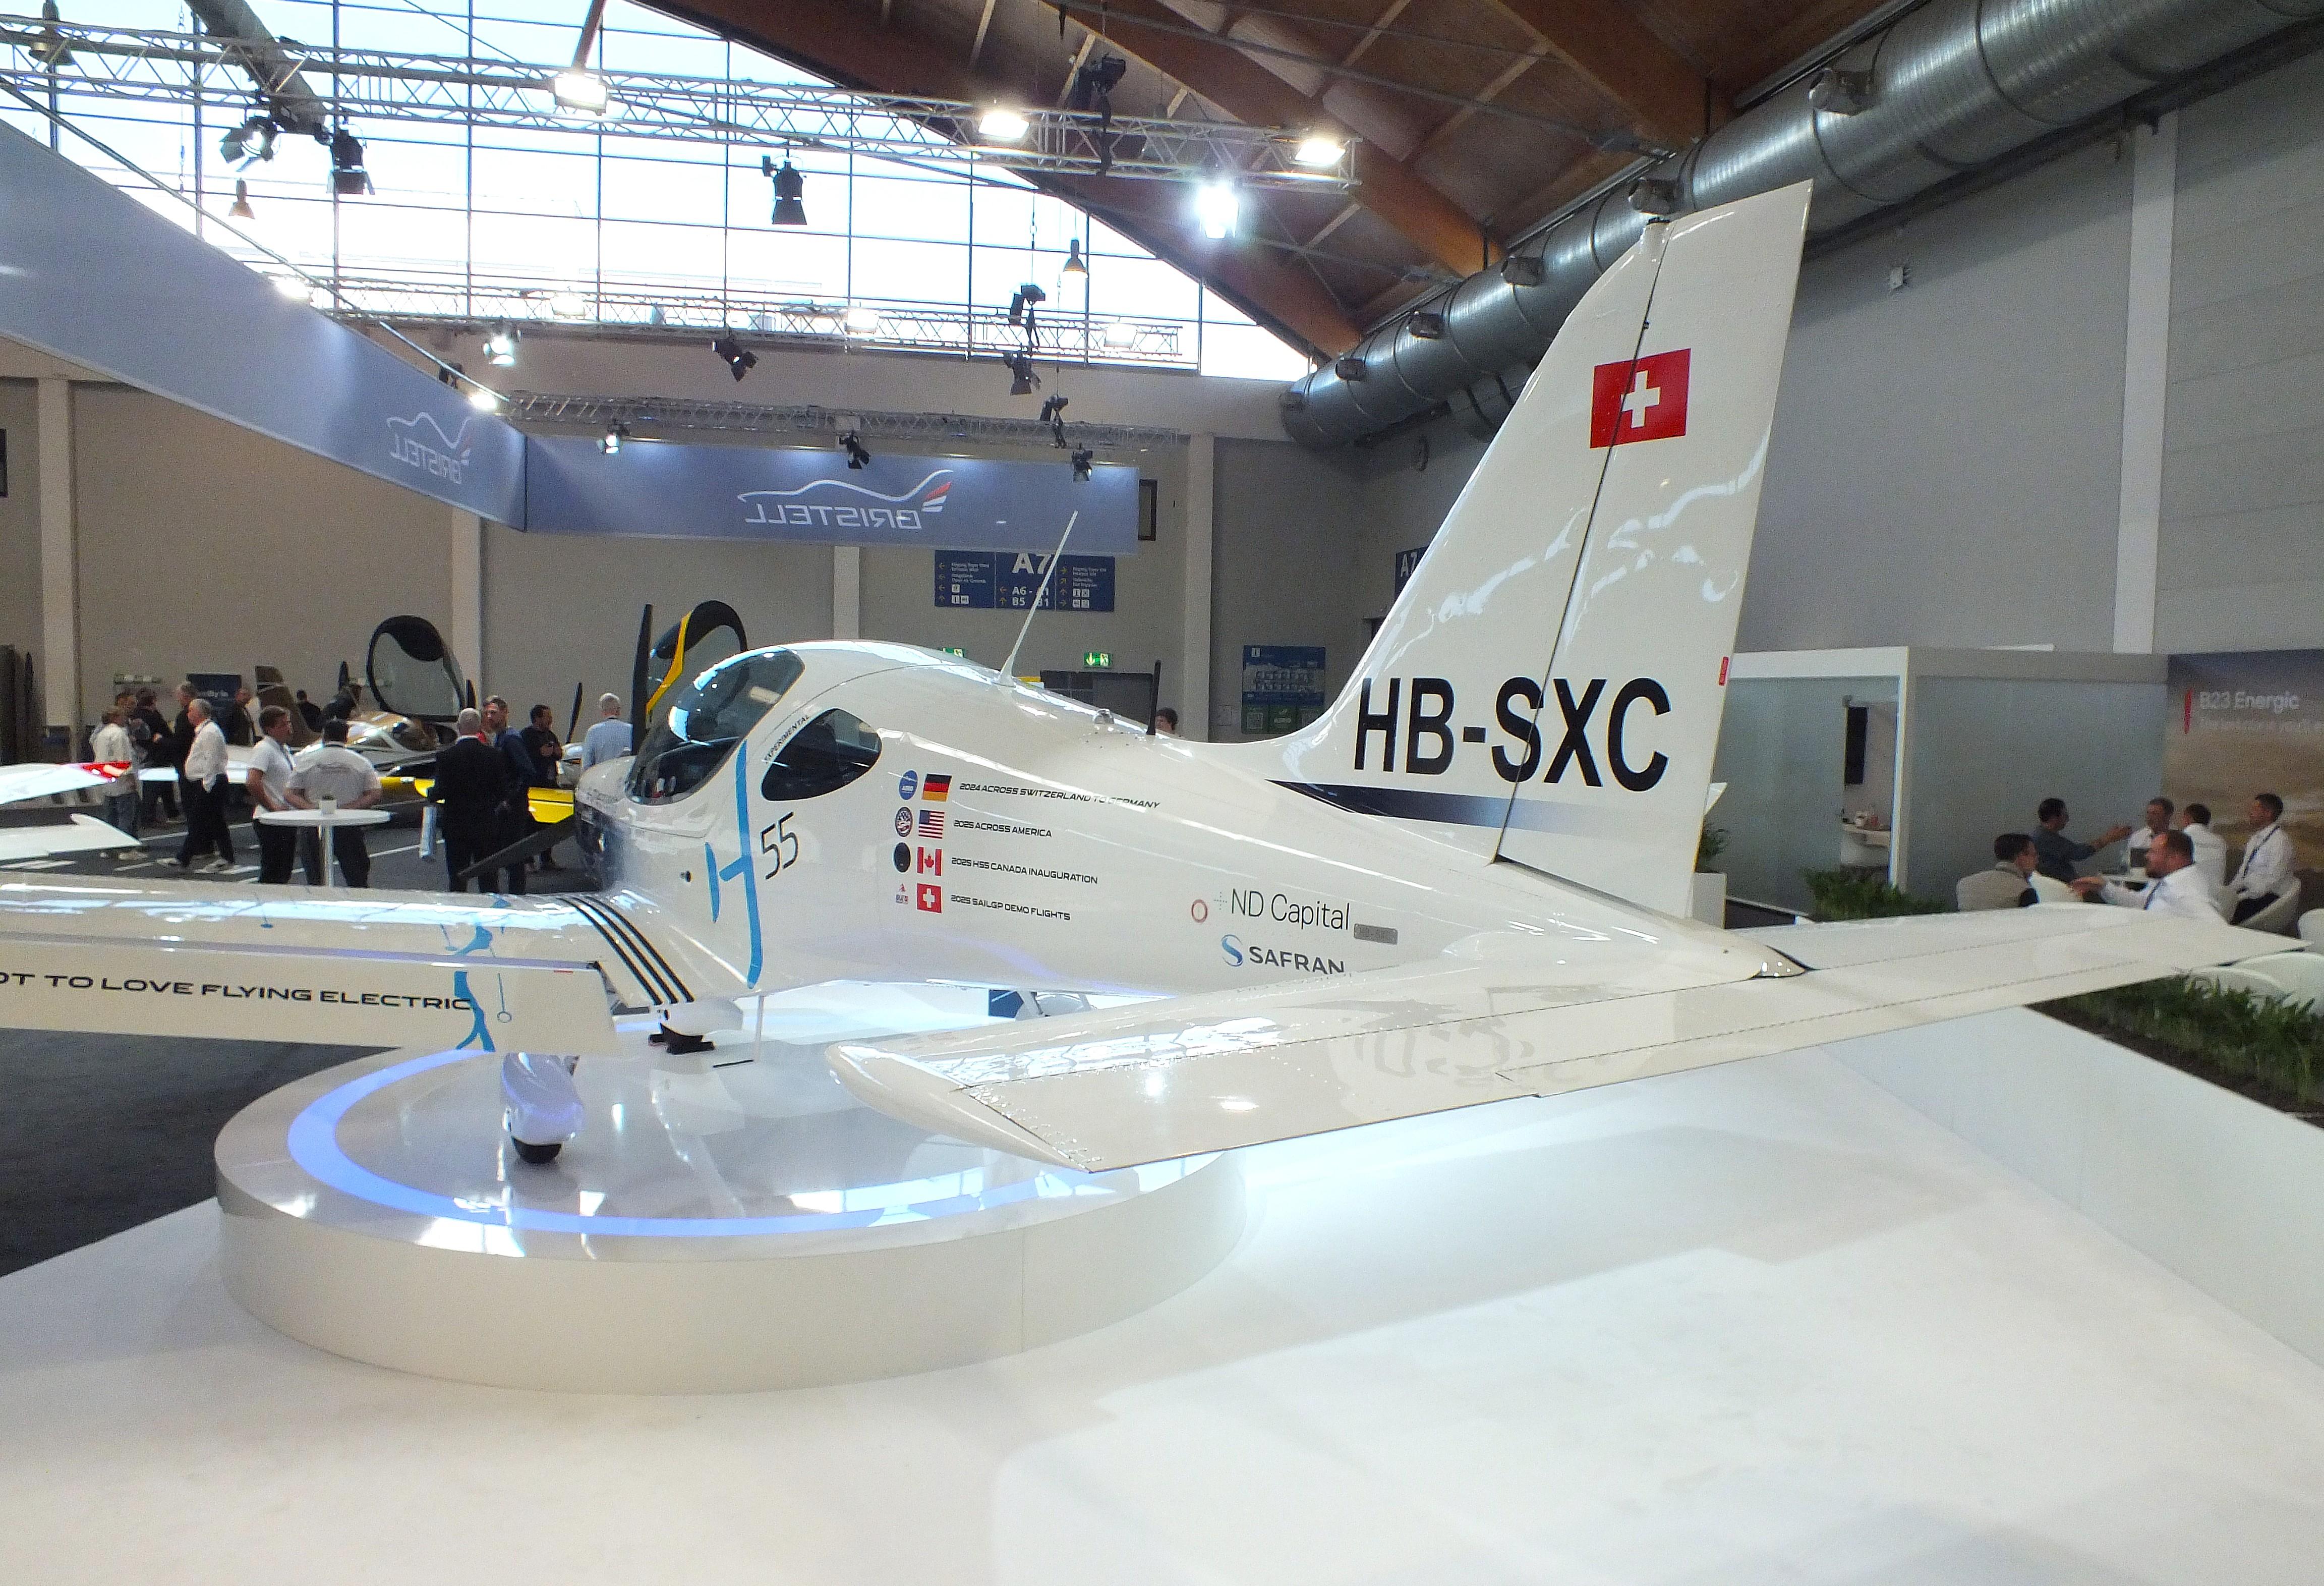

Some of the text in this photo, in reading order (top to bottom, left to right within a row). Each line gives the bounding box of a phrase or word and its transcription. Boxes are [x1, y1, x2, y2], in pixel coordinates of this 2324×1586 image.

[1012, 552, 1052, 574] A7
[1012, 586, 1027, 596] A6
[1012, 597, 1026, 606] B5
[2199, 691, 2231, 710] B23
[1354, 676, 1671, 792] HB-SXC
[959, 783, 981, 791] 2024
[981, 784, 1019, 795] ACROSS
[1019, 787, 1091, 802] SWITZERLAND
[954, 820, 1052, 838] 2025 ACROSS AMERICA
[951, 857, 972, 867] 2025
[991, 862, 1027, 875] CANADA
[1028, 867, 1098, 884] INAUGURATION
[951, 894, 1071, 921] 2025 SAILGP DEMO FLIGHTS
[1231, 888, 1351, 930] ND Capital
[1248, 945, 1345, 975] SAFRAN
[44, 974, 94, 988] TO
[101, 977, 194, 995] LOVE
[201, 984, 312, 1001] FLYING
[320, 990, 472, 1010] ELECTRIC
